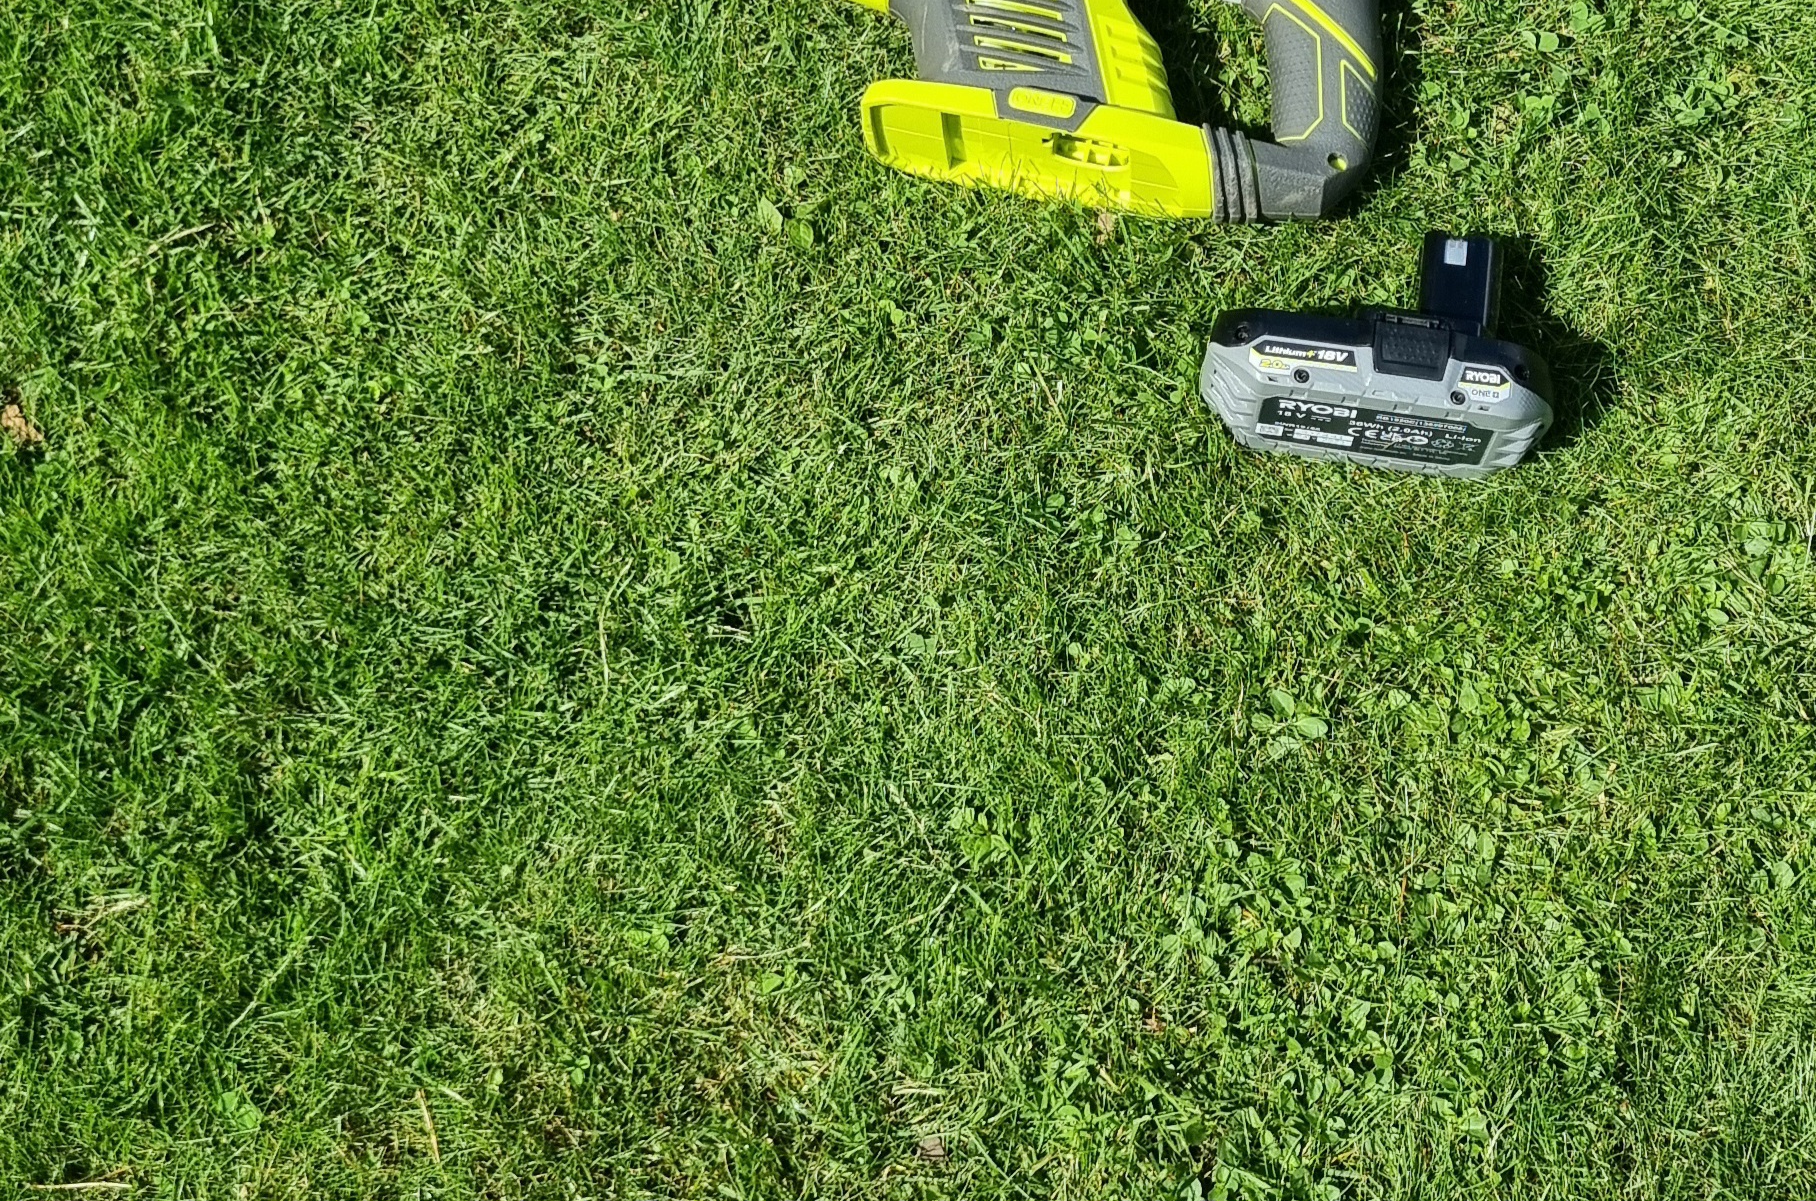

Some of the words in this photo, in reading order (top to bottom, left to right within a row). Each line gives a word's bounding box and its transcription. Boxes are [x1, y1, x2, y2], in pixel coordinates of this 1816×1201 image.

[1264, 345, 1315, 358] Lithium+
[1317, 349, 1349, 362] 18V
[1464, 370, 1501, 384] RYOBI
[1278, 399, 1358, 419] RYOBI
[1387, 426, 1433, 437] (2.0Ah)
